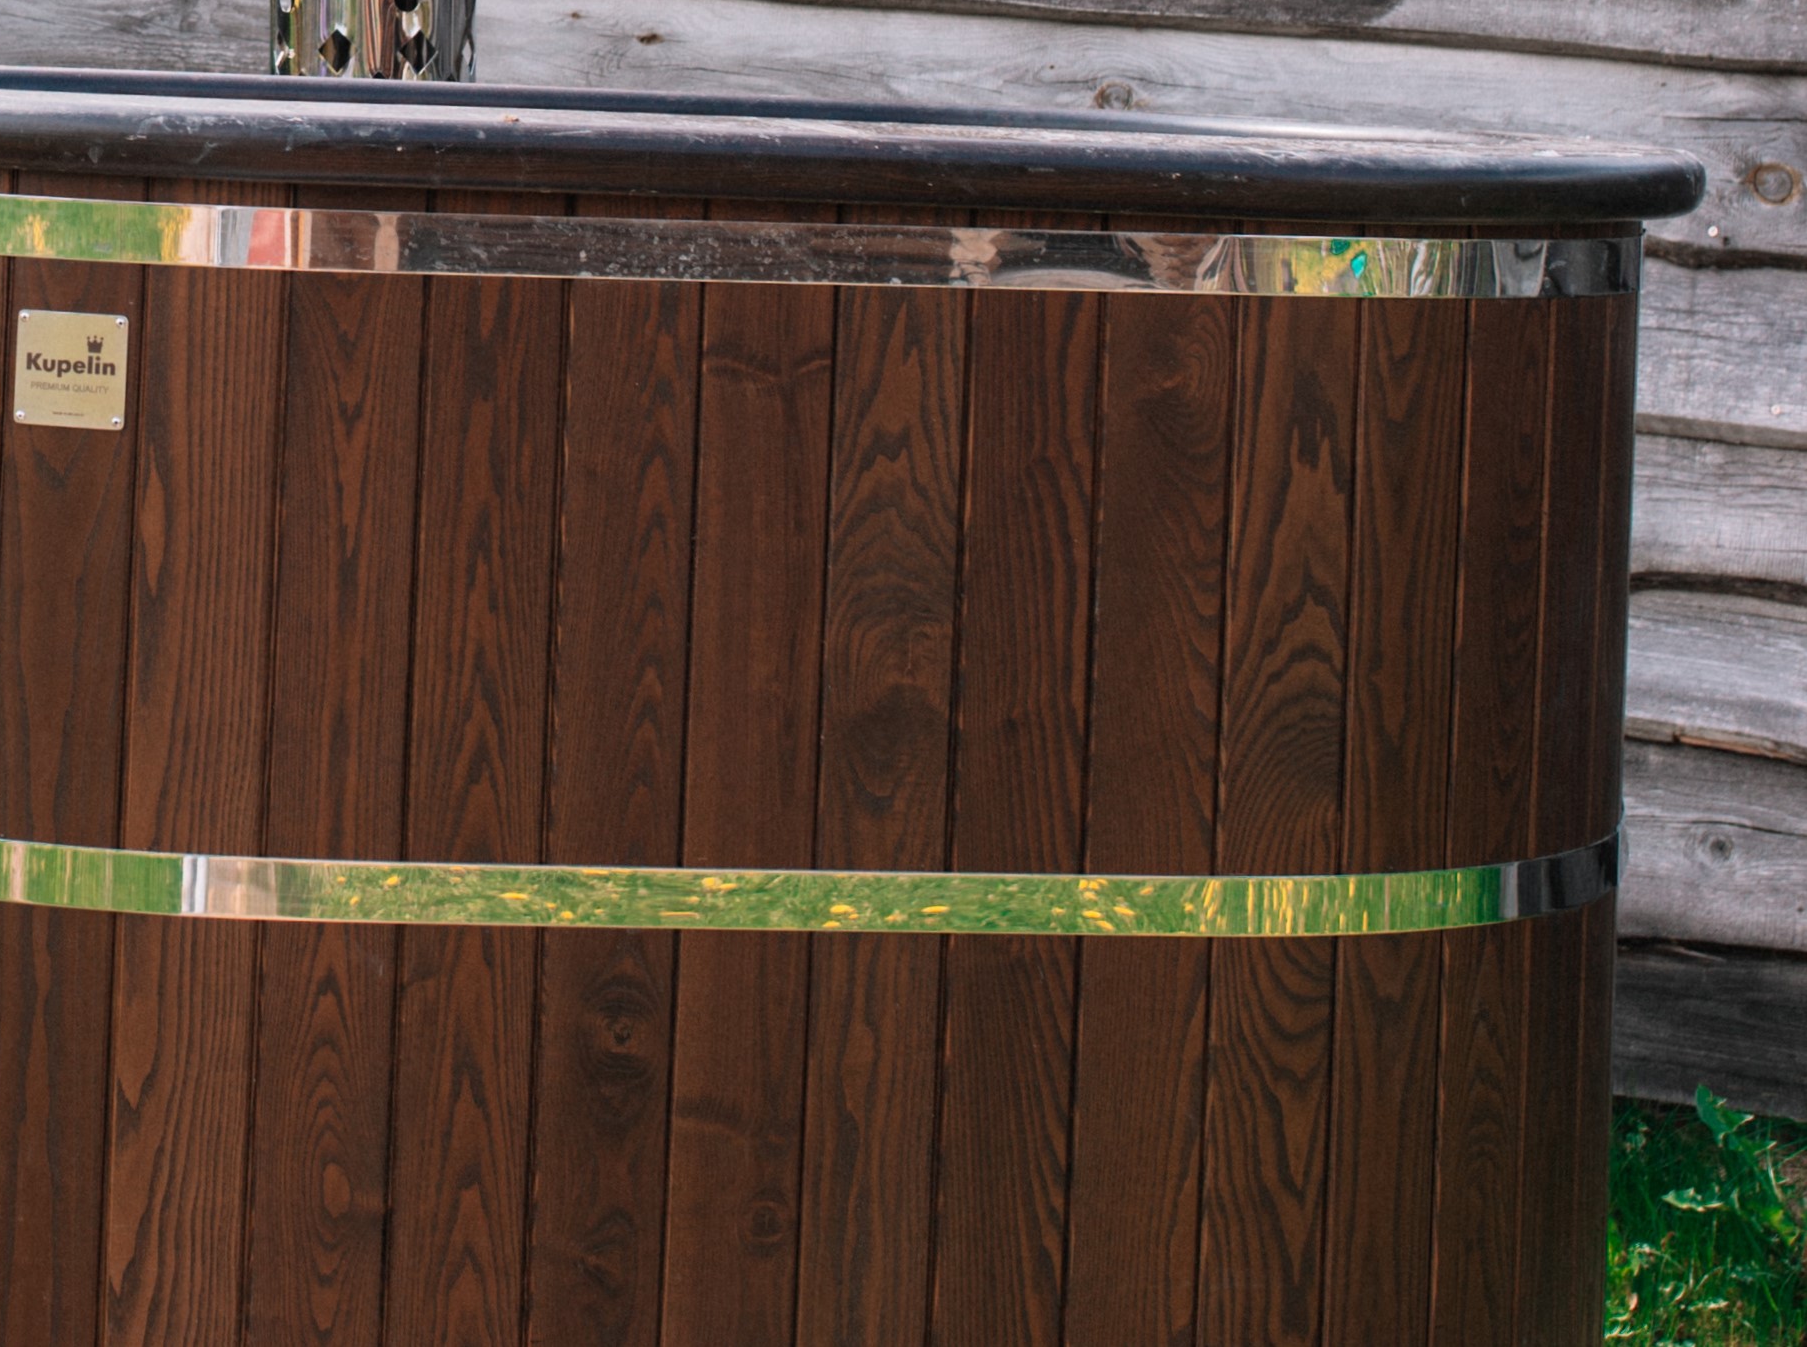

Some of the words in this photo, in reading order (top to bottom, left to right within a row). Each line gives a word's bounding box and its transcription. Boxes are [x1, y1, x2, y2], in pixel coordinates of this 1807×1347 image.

[25, 352, 116, 378] Kupelin
[30, 381, 70, 392] PREMIUM
[72, 383, 109, 394] QUALITY
